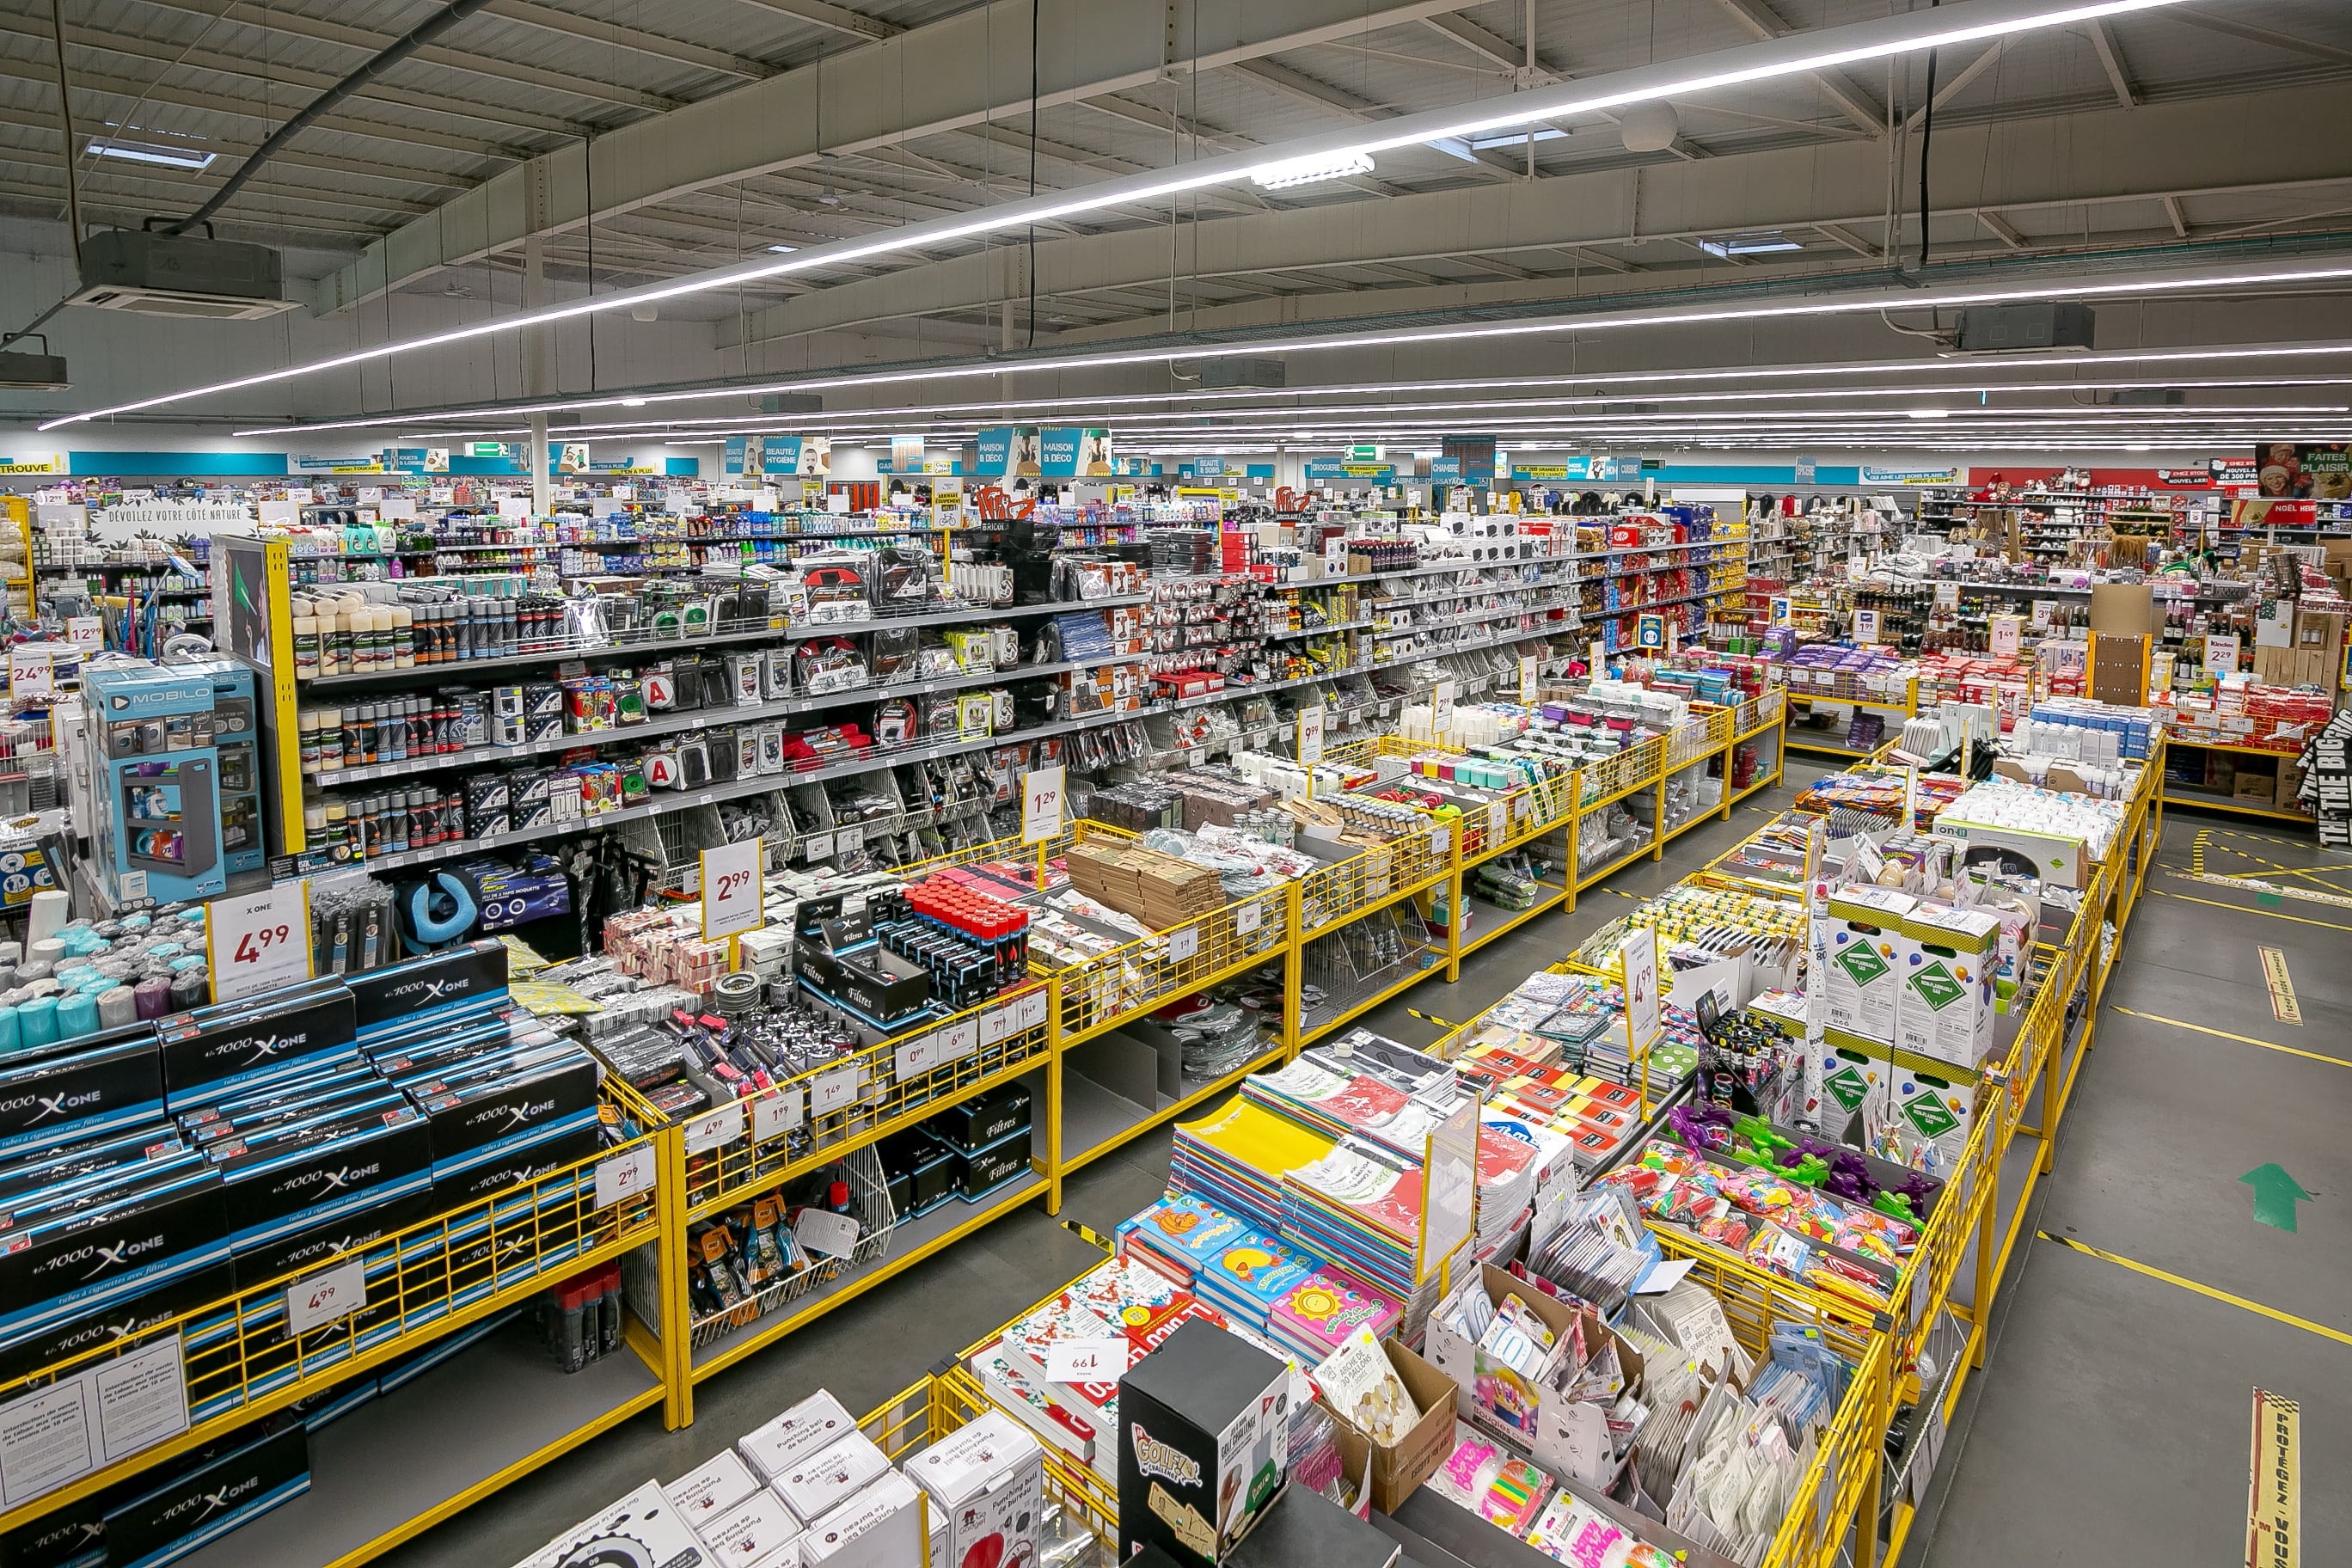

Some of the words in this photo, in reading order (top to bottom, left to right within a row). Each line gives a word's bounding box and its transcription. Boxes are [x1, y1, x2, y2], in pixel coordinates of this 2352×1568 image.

[1044, 443, 1074, 451] MAISON
[766, 456, 796, 464] HYGIÈNE
[986, 453, 1003, 462] DÉCO
[1050, 453, 1072, 462] DÉCO
[2307, 453, 2346, 462] FAITES
[1433, 464, 1459, 473] CHAMBRE
[2300, 462, 2349, 473] PLAISIR
[108, 508, 153, 523] DÉVOILEZ
[156, 510, 183, 522] VOTRE
[186, 507, 208, 521] CÔTÉ
[210, 509, 242, 521] NATURE
[2275, 502, 2298, 512] NOËL
[132, 688, 211, 704] MOBILO
[255, 902, 273, 912] ONE
[843, 932, 863, 943] Filtres
[802, 962, 825, 985] Filtres
[445, 978, 469, 991] ONE
[848, 987, 873, 1008] Filtres
[279, 1033, 307, 1048] ONE
[66, 1090, 101, 1108] ONE
[530, 1099, 555, 1114] ONE
[986, 1116, 1017, 1139] Filtres
[350, 1161, 380, 1181] ONE
[532, 1161, 557, 1178] ONE
[989, 1157, 1019, 1181] Filtres
[1694, 1325, 1714, 1340] BALLON
[1340, 1356, 1358, 1376] ARCHE
[1357, 1349, 1366, 1361] DE
[1341, 1377, 1351, 1387] 30
[1349, 1354, 1372, 1380] BALLONS
[105, 1374, 144, 1392] Interdiction
[155, 1361, 174, 1374] vente
[1473, 1406, 1511, 1440] Bougies
[777, 1424, 805, 1449] Punching
[806, 1418, 824, 1432] ball
[787, 1441, 797, 1450] de
[797, 1426, 822, 1447] bureau
[699, 1475, 711, 1485] de
[672, 1482, 701, 1501] bureau
[689, 1476, 722, 1502] Punching
[992, 1481, 1024, 1511] Punching
[1024, 1471, 1038, 1488] ball
[873, 1503, 885, 1514] de
[997, 1504, 1007, 1516] de
[1008, 1486, 1032, 1508] bureau
[729, 1515, 763, 1540] Punching
[738, 1514, 751, 1525] de
[843, 1513, 873, 1533] bureau
[861, 1505, 899, 1535] Punching
[569, 1518, 601, 1541] meilleur
[712, 1524, 740, 1543] bureau
[841, 1531, 862, 1546] ball
[586, 1546, 598, 1557] 25
